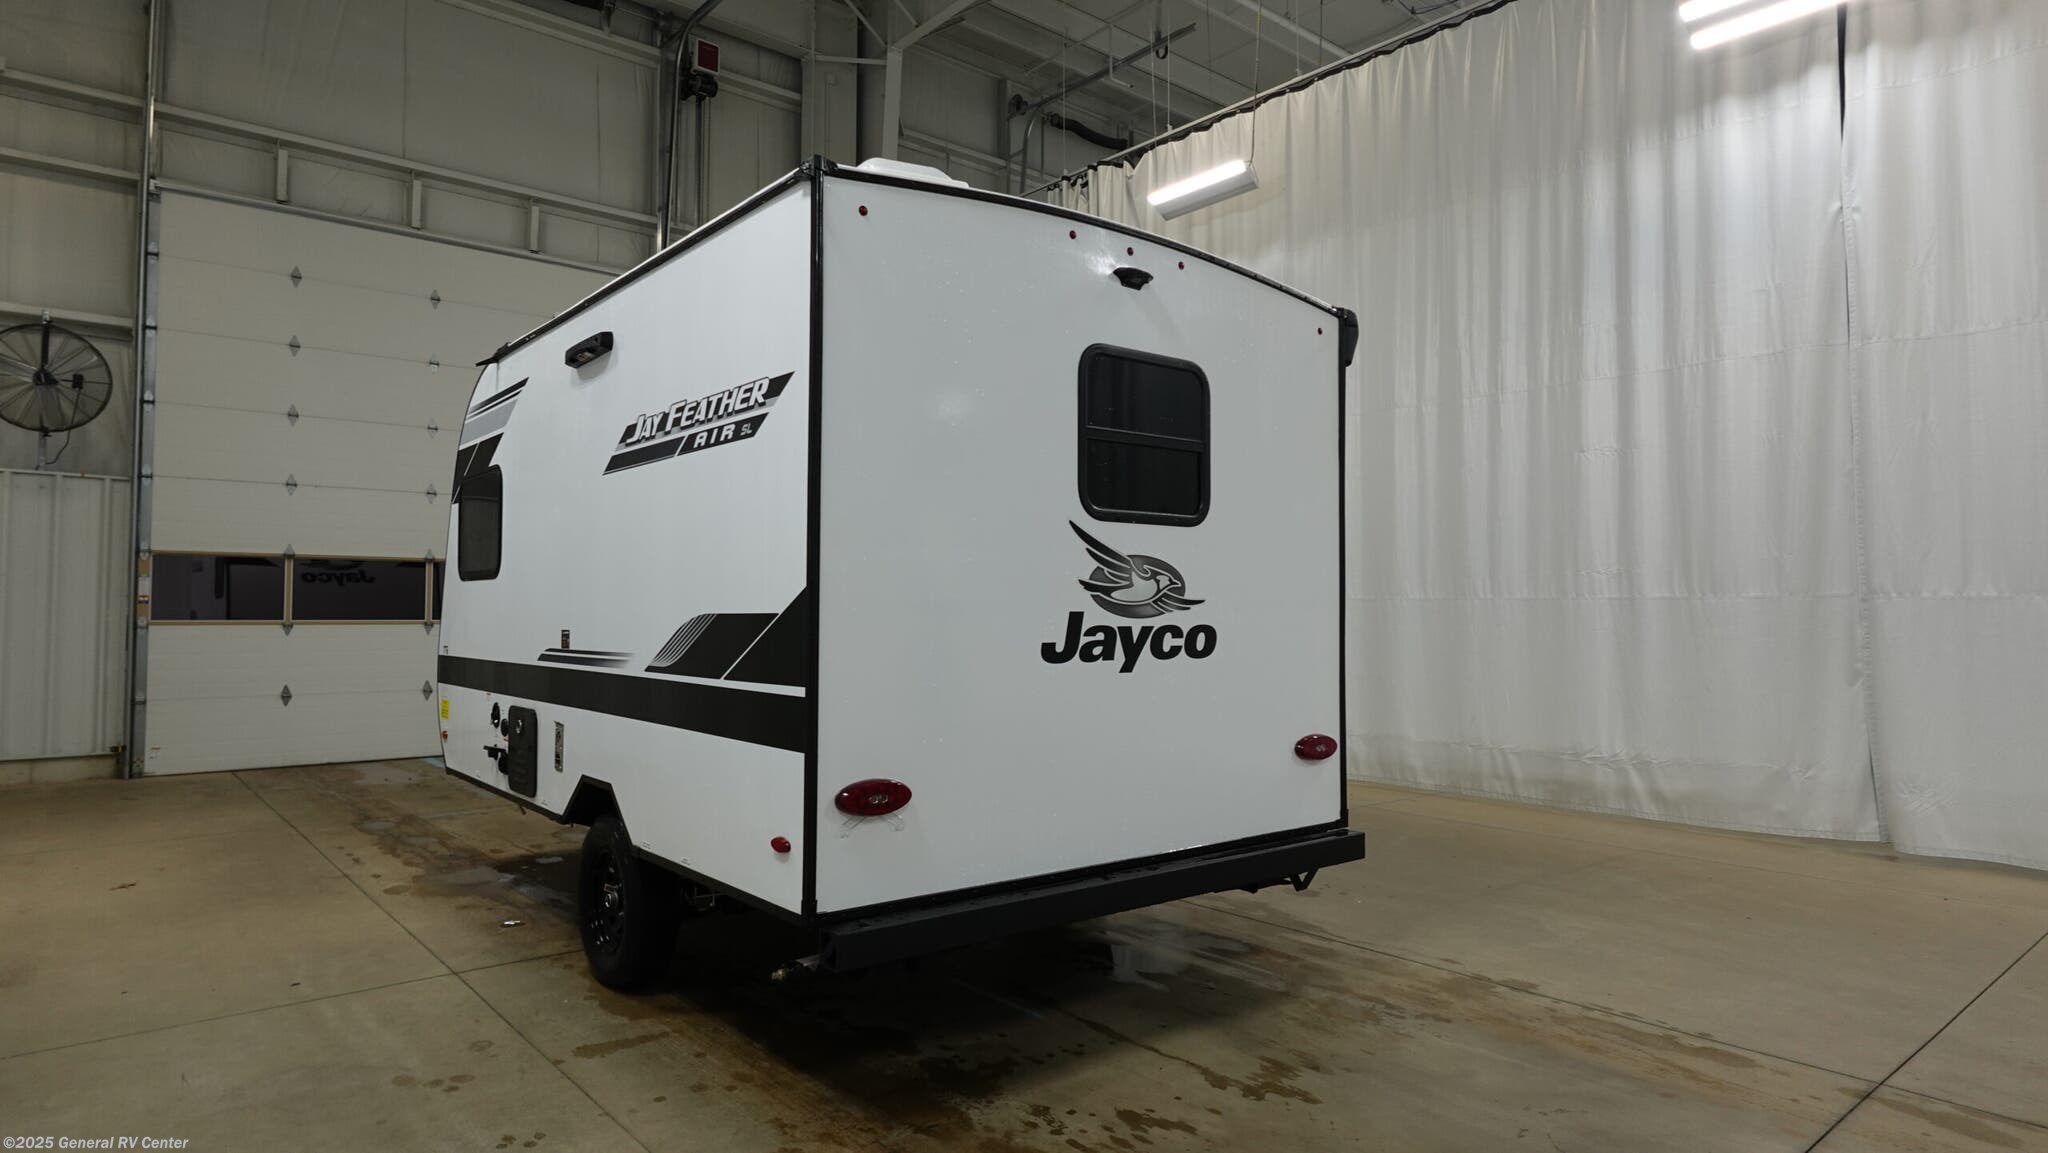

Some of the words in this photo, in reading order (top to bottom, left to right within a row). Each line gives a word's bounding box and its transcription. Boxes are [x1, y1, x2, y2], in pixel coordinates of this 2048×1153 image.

[625, 413, 667, 446] JAY
[664, 376, 771, 436] FEATHER
[693, 423, 736, 449] AIR
[740, 423, 753, 436] SL
[1041, 611, 1217, 673] Jayco
